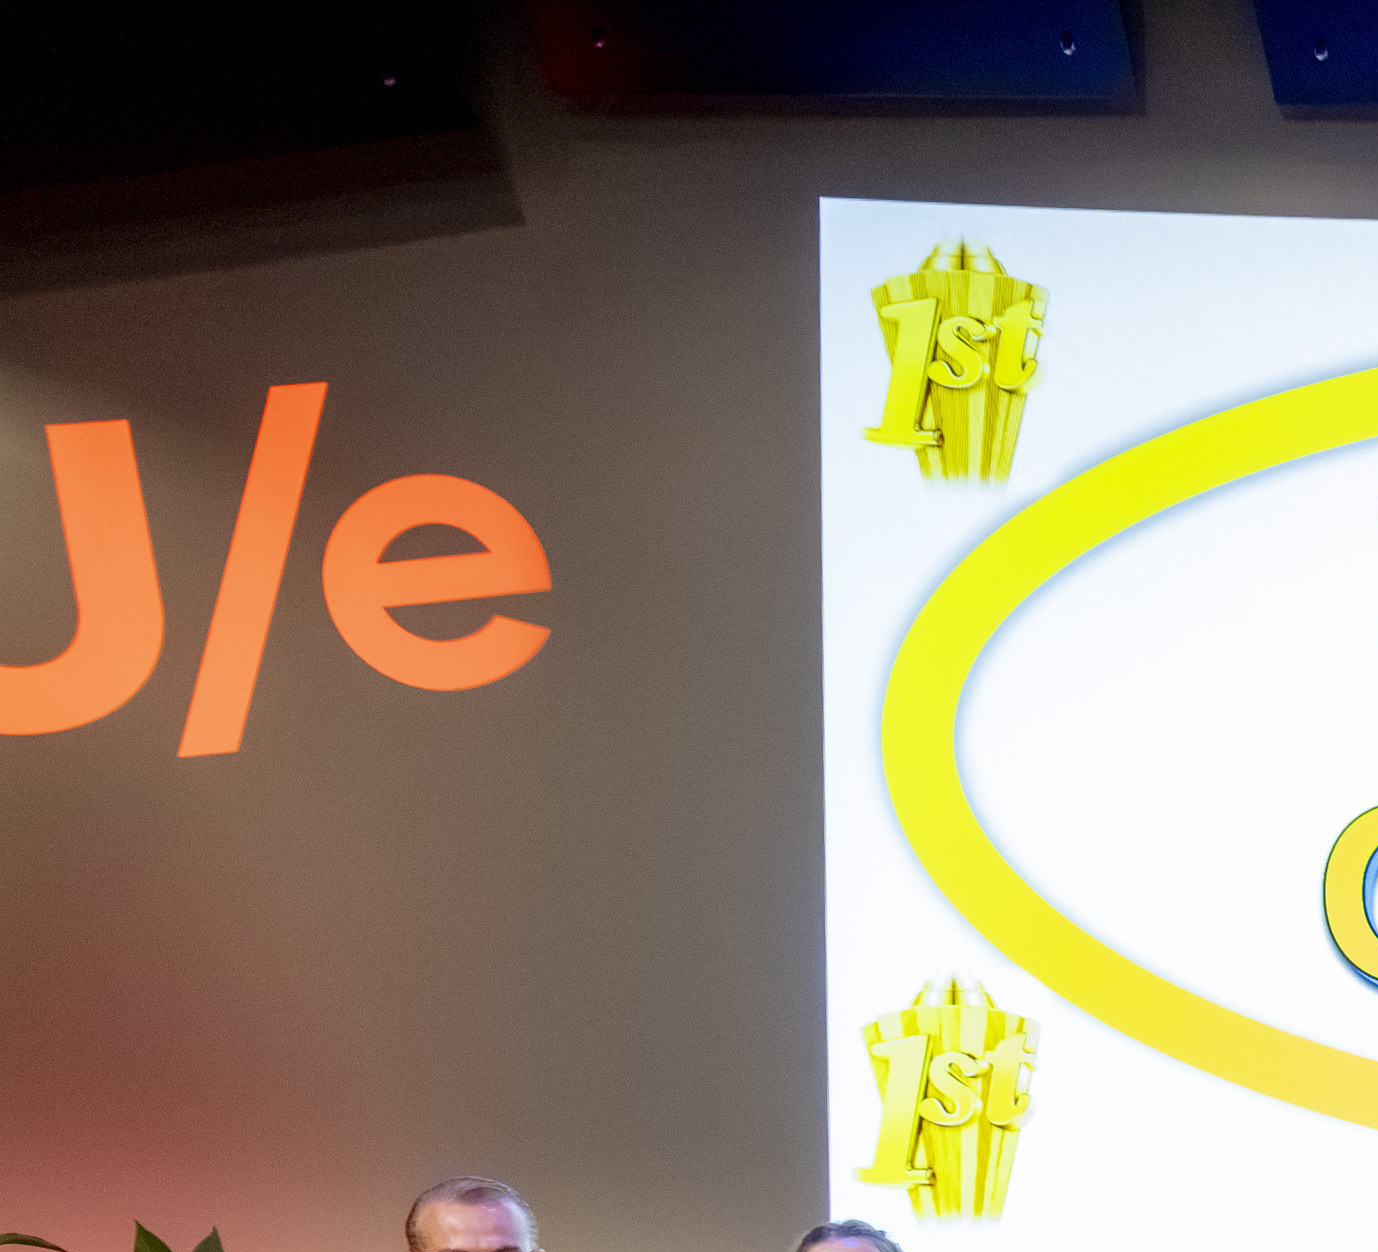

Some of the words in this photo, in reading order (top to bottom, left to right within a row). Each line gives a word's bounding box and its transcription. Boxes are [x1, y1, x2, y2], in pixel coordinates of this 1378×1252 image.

[861, 294, 1046, 448] 1st
[0, 382, 552, 758] U/e
[853, 1032, 1037, 1187] 1st
